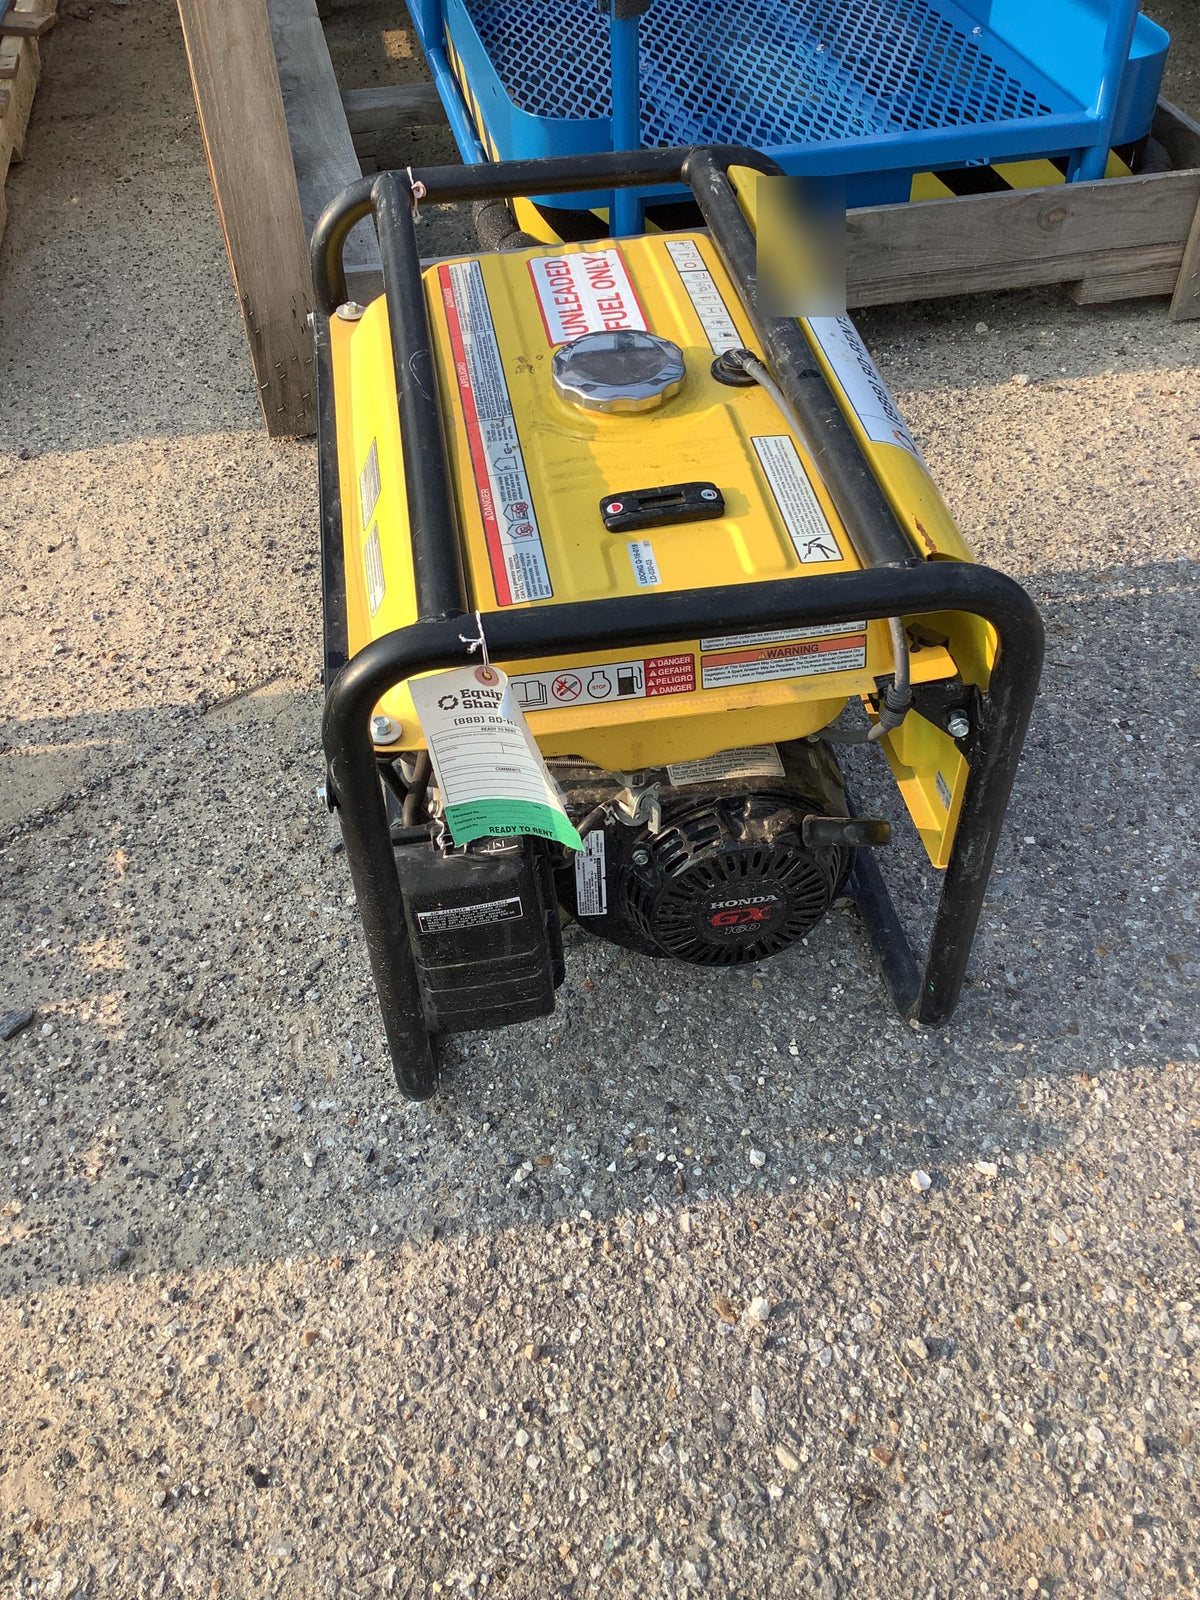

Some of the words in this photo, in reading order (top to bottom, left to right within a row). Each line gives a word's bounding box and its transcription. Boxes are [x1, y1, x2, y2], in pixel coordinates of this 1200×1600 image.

[544, 261, 589, 336] UNLEADED
[597, 292, 631, 331] FUEL
[457, 361, 468, 384] PELIGRO
[479, 488, 493, 515] DANGER
[766, 643, 818, 658] WARNING
[658, 656, 691, 667] DANGER
[658, 666, 691, 676] GEFAHR
[656, 675, 692, 685] PELIGRO
[659, 684, 692, 694] DANGER
[454, 716, 484, 725] (888)
[533, 828, 553, 837] RENT
[710, 895, 779, 909] HONDA
[711, 905, 773, 926] GX
[725, 923, 760, 935] 160
